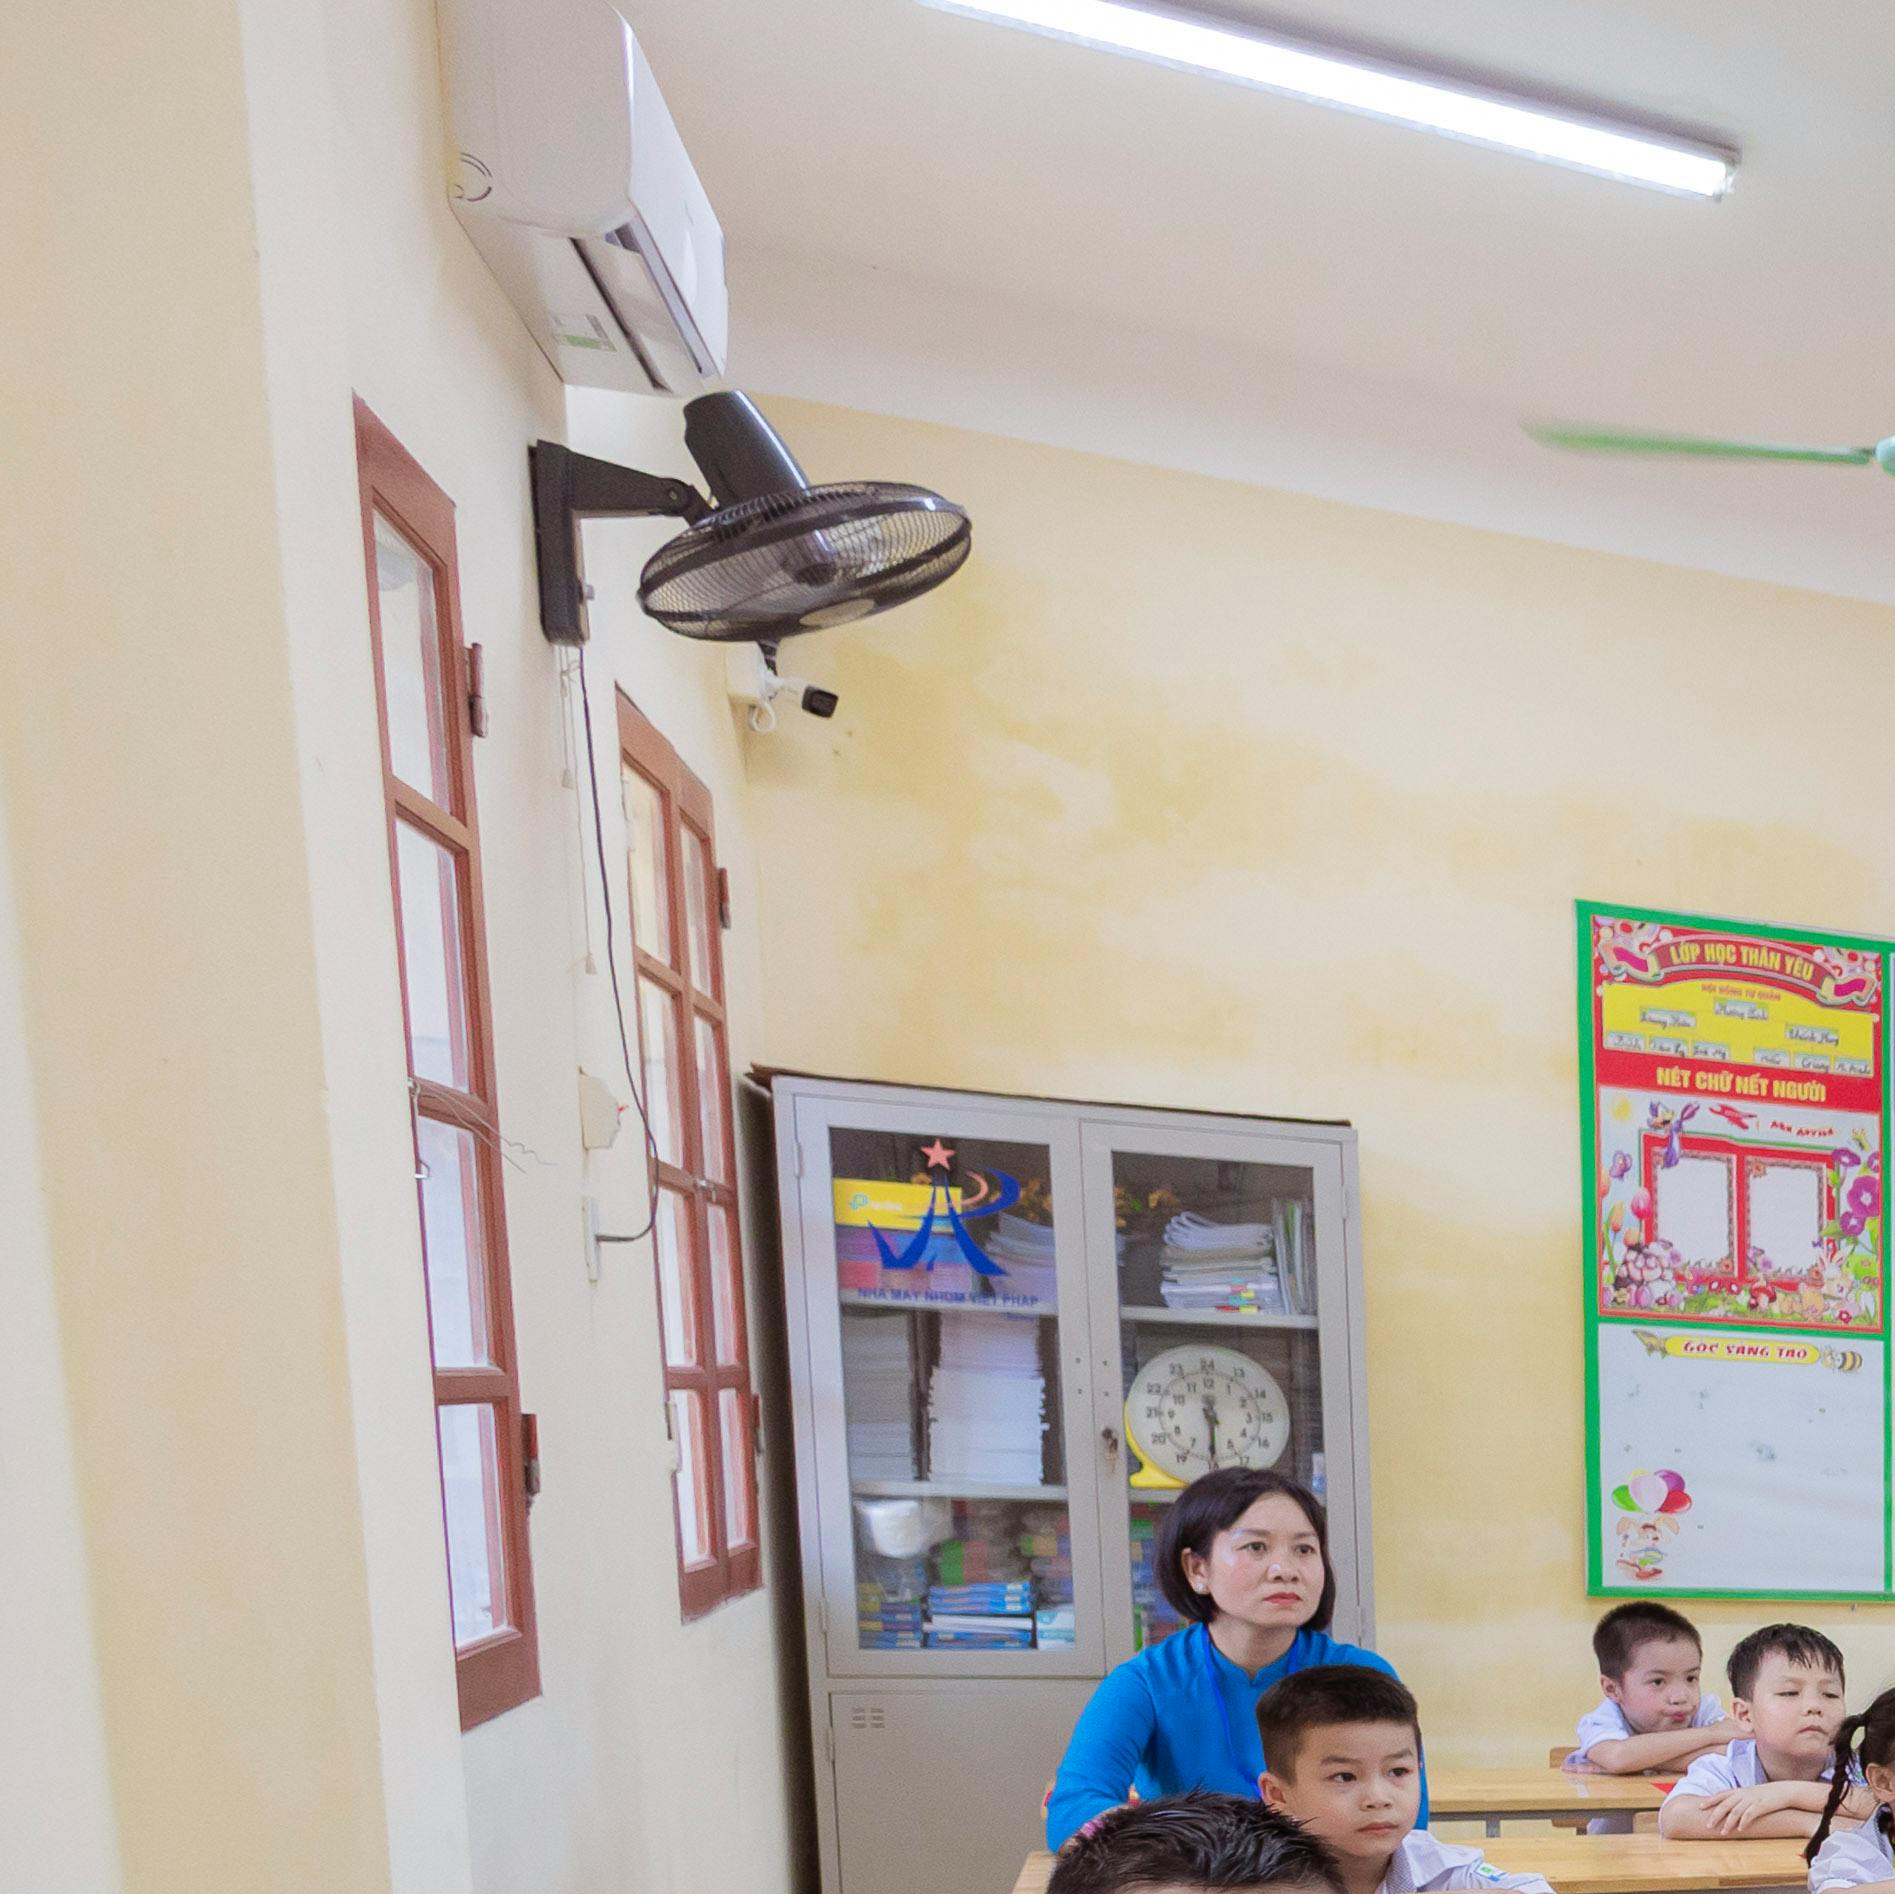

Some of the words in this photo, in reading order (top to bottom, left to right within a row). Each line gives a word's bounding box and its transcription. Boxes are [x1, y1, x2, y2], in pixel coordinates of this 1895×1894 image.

[1669, 942, 1700, 964] LỚP
[1705, 944, 1736, 967] HỌC
[1741, 945, 1780, 970] THÂN
[1785, 953, 1814, 981] YÊU
[1656, 1065, 1691, 1088] NÉT
[1695, 1068, 1733, 1092] CHỮ
[1772, 1078, 1826, 1102] NGƯỜI
[1200, 1359, 1215, 1372] 24
